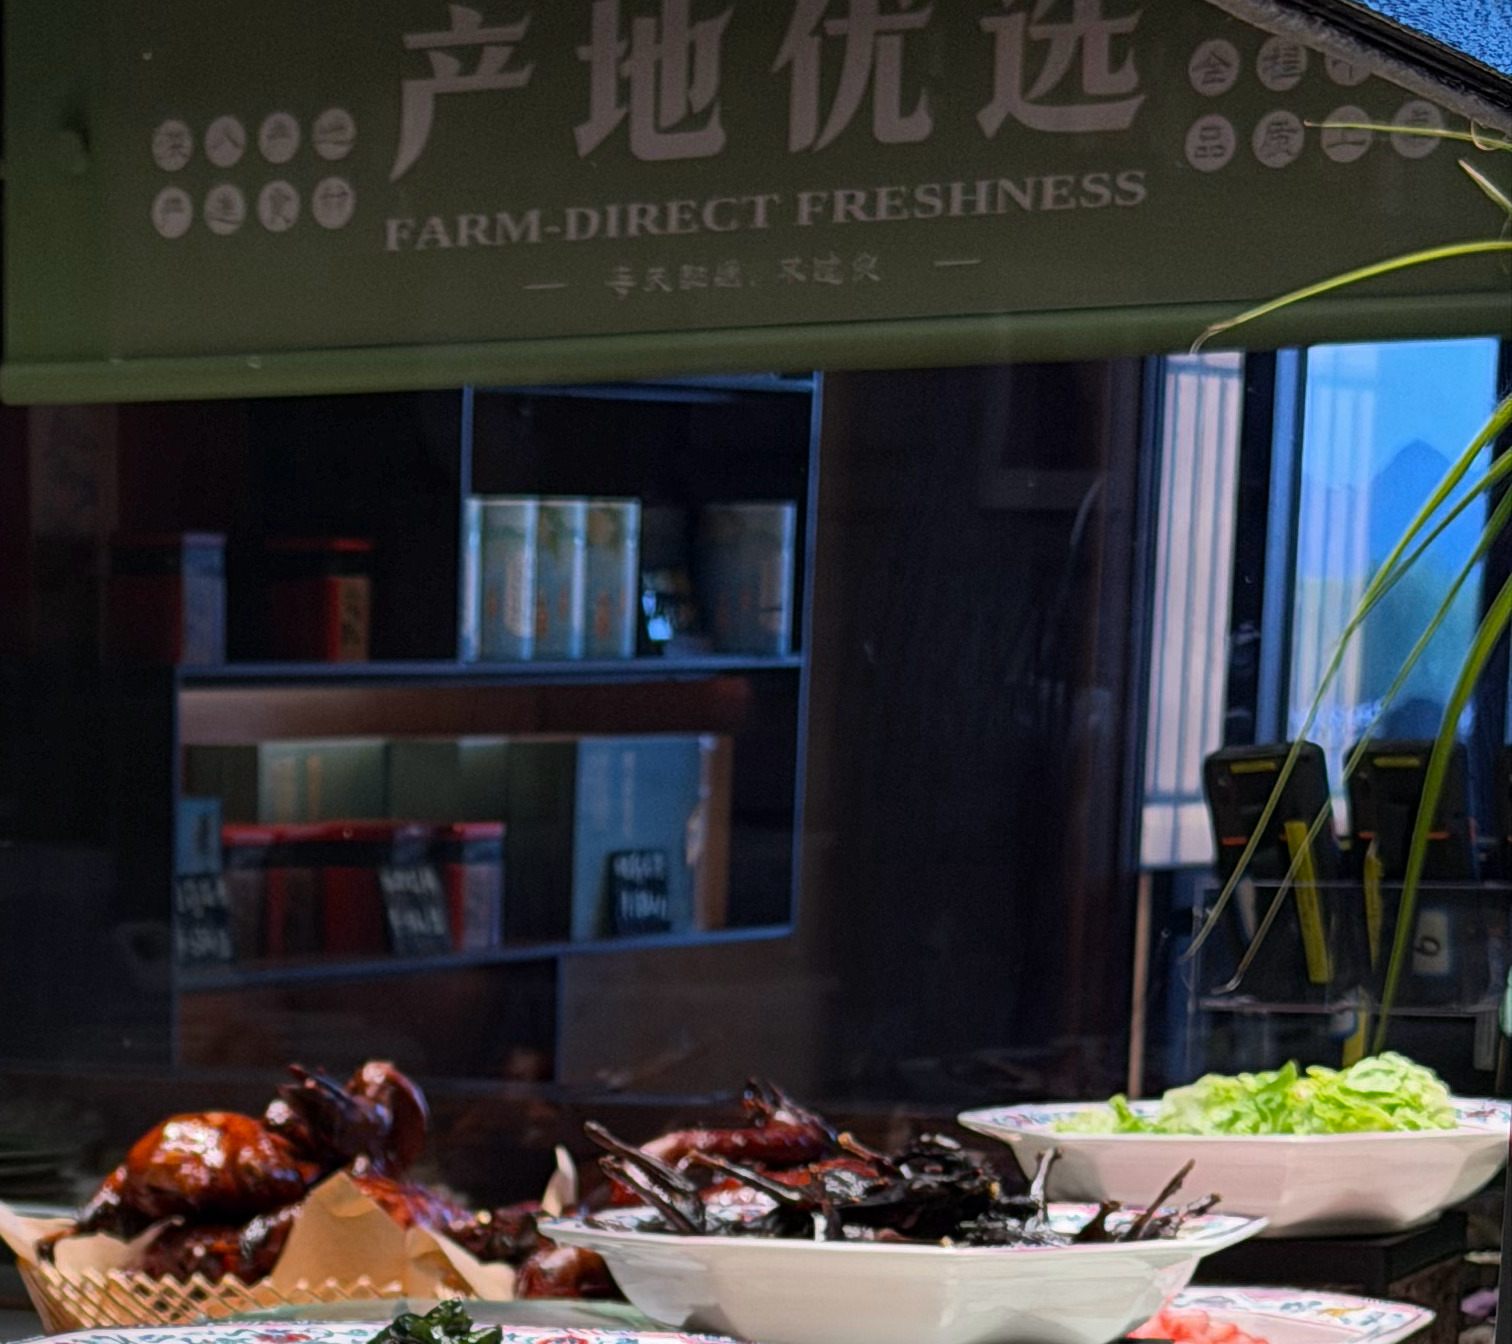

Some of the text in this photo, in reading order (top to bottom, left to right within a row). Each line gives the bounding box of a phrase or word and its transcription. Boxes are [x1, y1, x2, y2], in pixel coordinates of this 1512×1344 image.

[388, 0, 1146, 184] 产地优选
[385, 169, 1147, 253] FARM-DIRECT FRESHNESS
